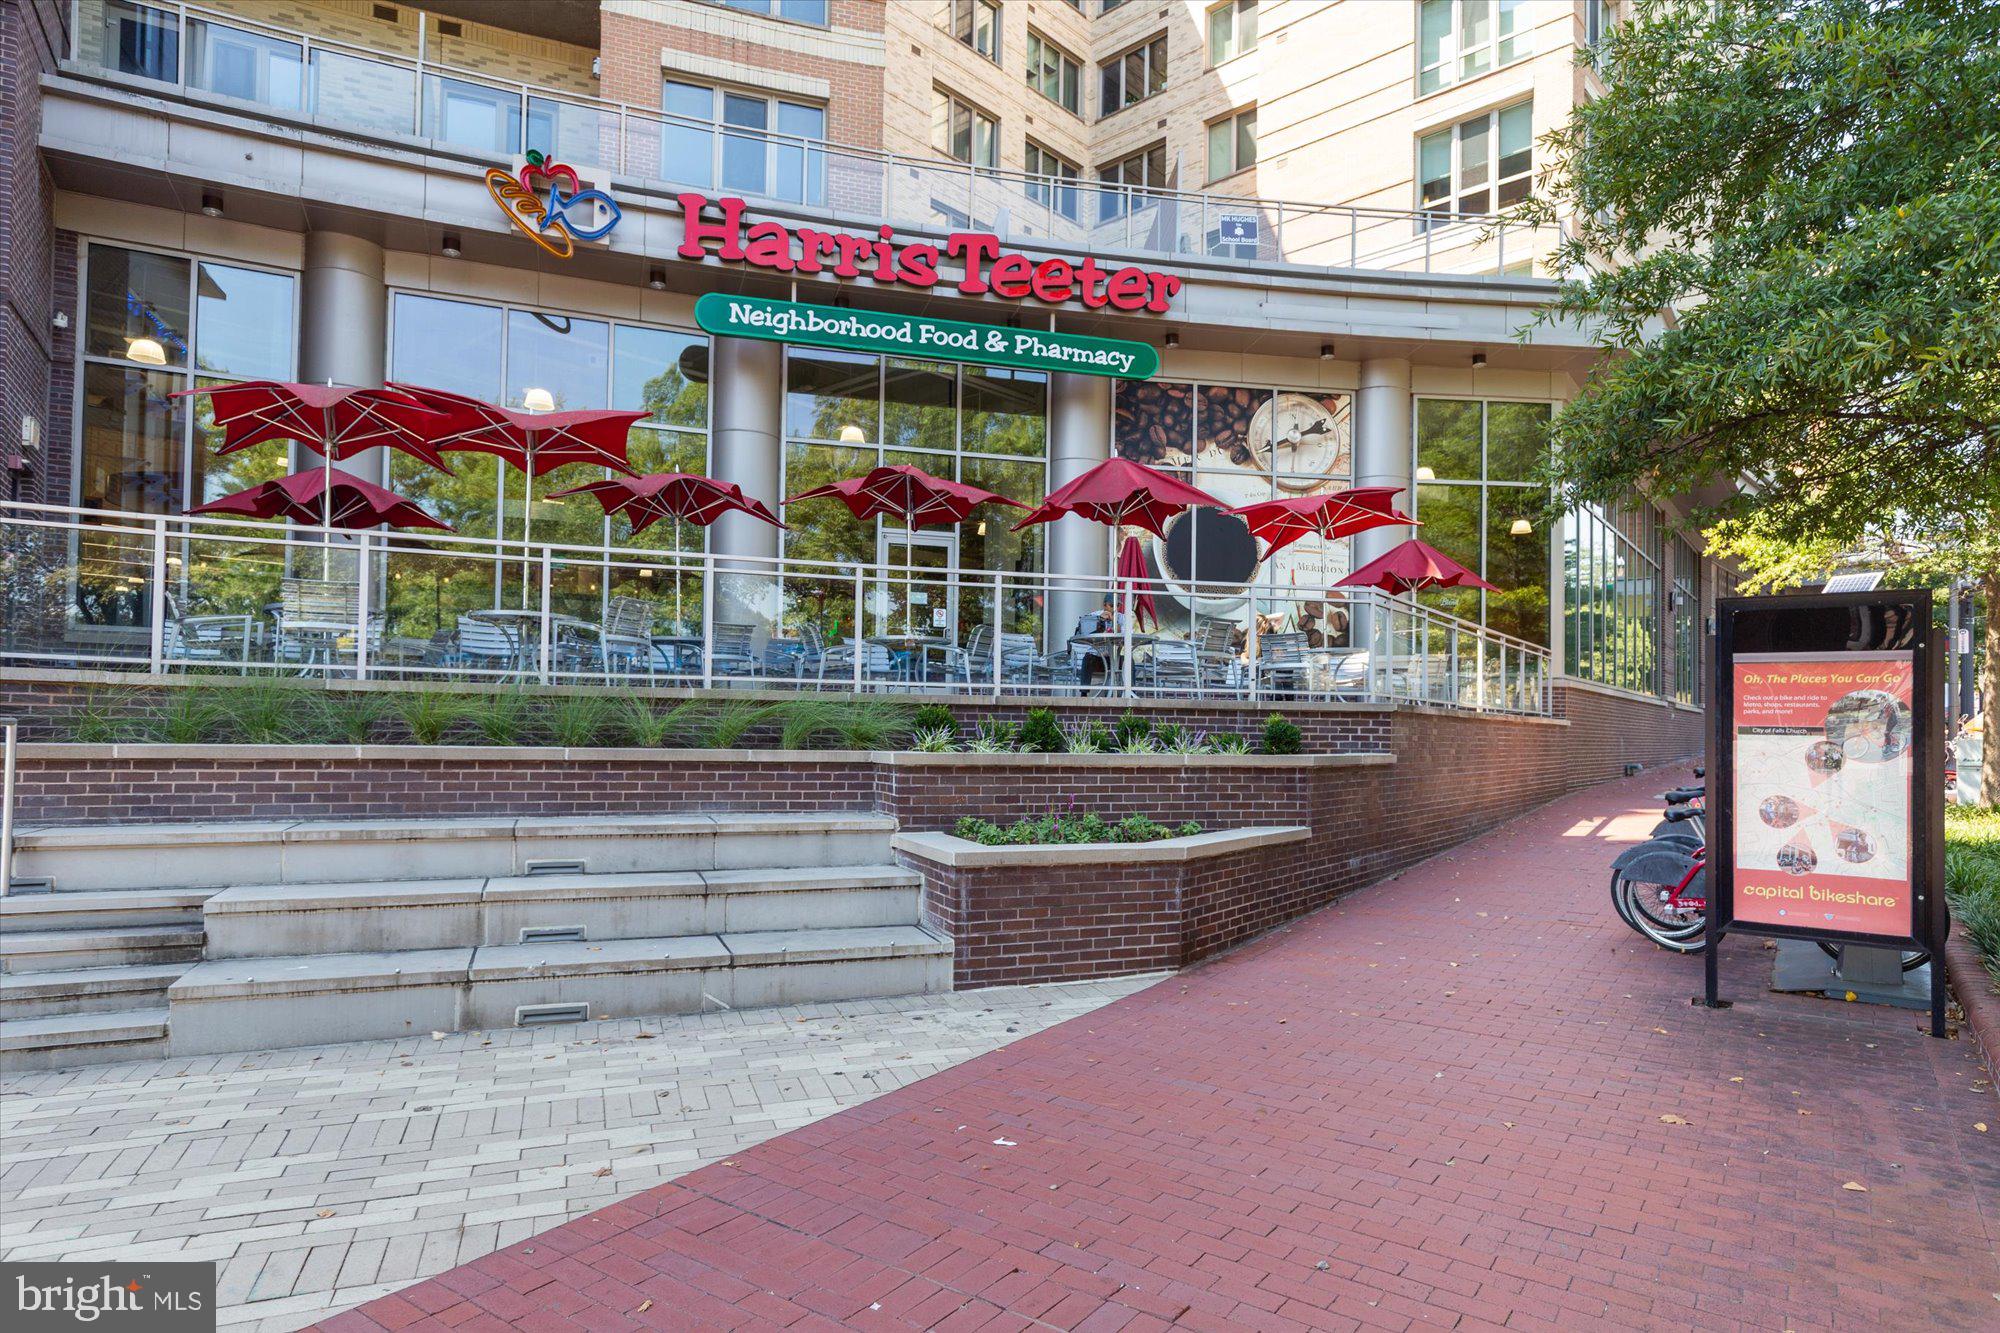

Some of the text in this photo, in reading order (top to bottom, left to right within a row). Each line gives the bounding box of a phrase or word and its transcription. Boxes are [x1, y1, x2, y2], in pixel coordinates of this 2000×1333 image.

[677, 193, 1181, 314] Harris Teeter
[729, 302, 1136, 373] Neighborhood Food & Pharmacy
[1743, 674, 1763, 685] Oh,
[1766, 674, 1787, 684] The
[1790, 673, 1827, 684] Places
[1830, 674, 1852, 684] You
[1856, 673, 1880, 684] Can
[1743, 885, 1896, 907] capital bikeshare
